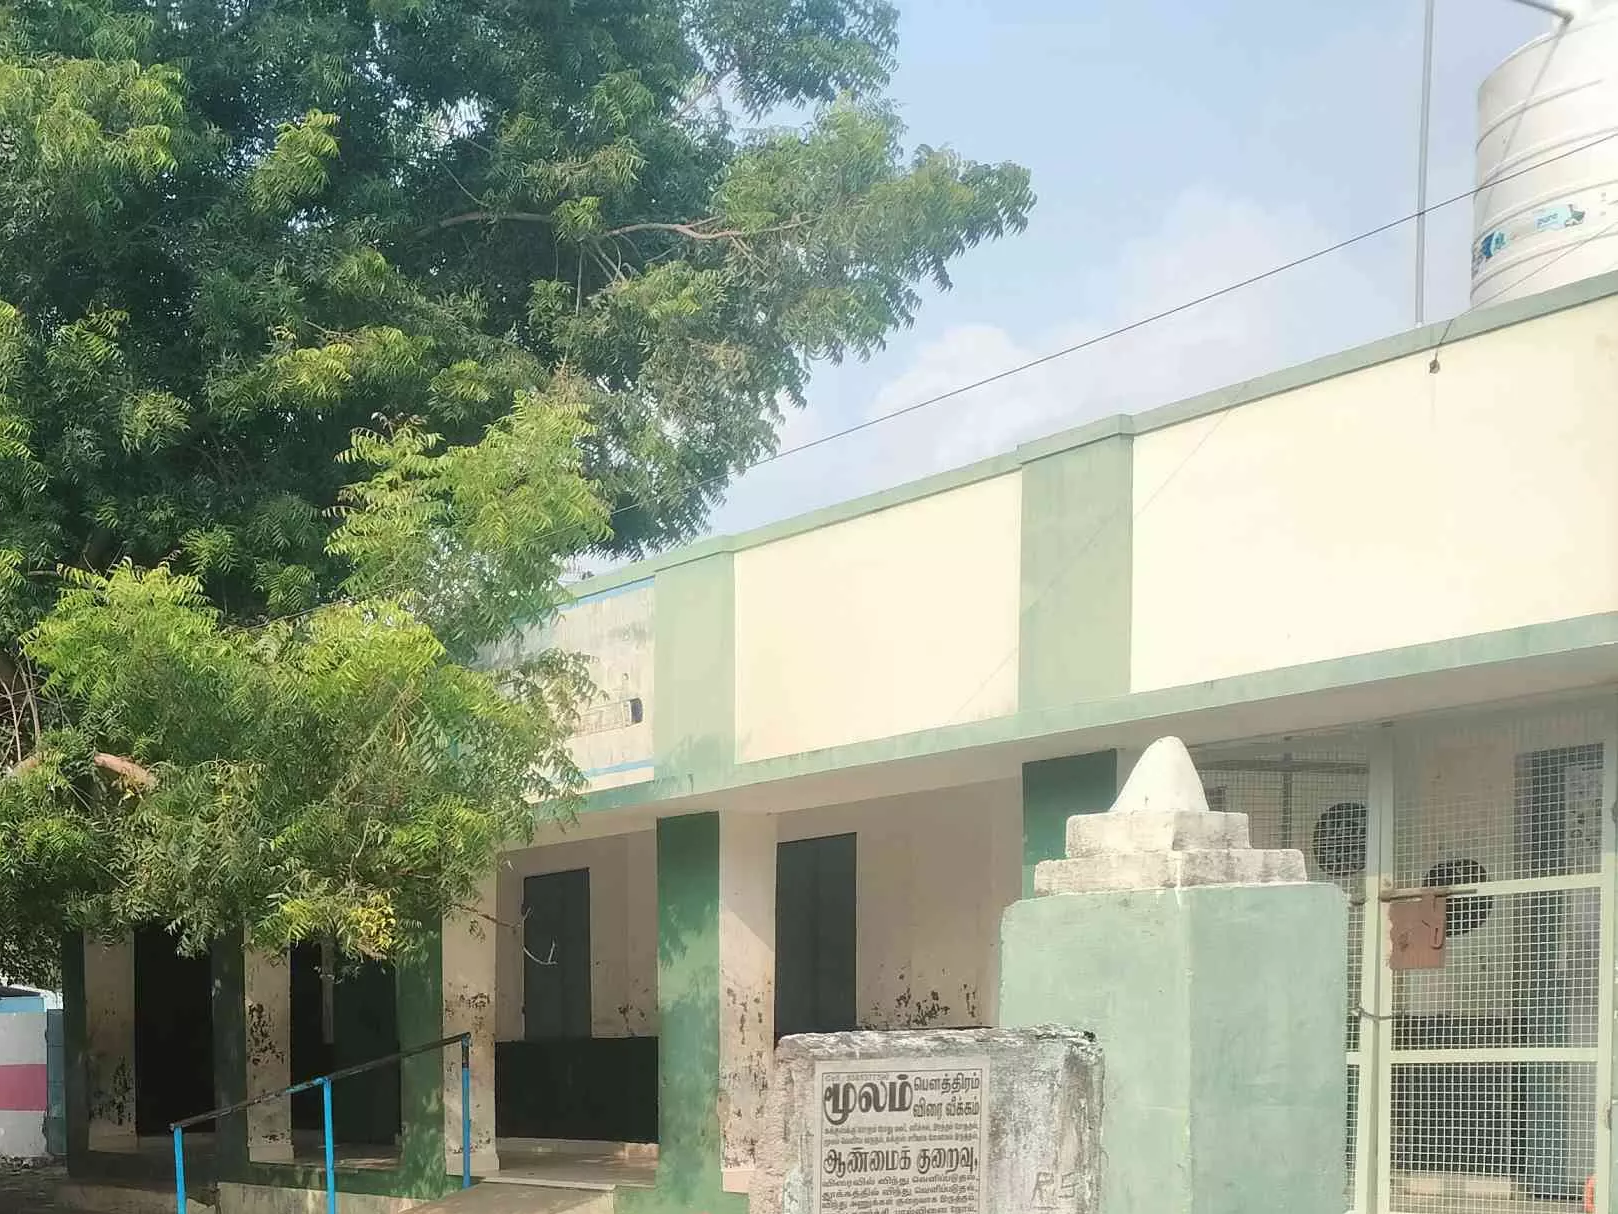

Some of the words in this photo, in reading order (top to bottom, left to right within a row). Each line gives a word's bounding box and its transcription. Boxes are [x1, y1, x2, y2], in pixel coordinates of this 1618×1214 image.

[914, 1072, 980, 1094] பௌத்திரம்
[824, 1074, 913, 1125] மூலம்
[913, 1098, 942, 1119] விரை
[945, 1096, 979, 1117] வீக்கம்
[823, 1146, 912, 1178] ஆண்மைக்
[917, 1146, 978, 1174] குறைவு,
